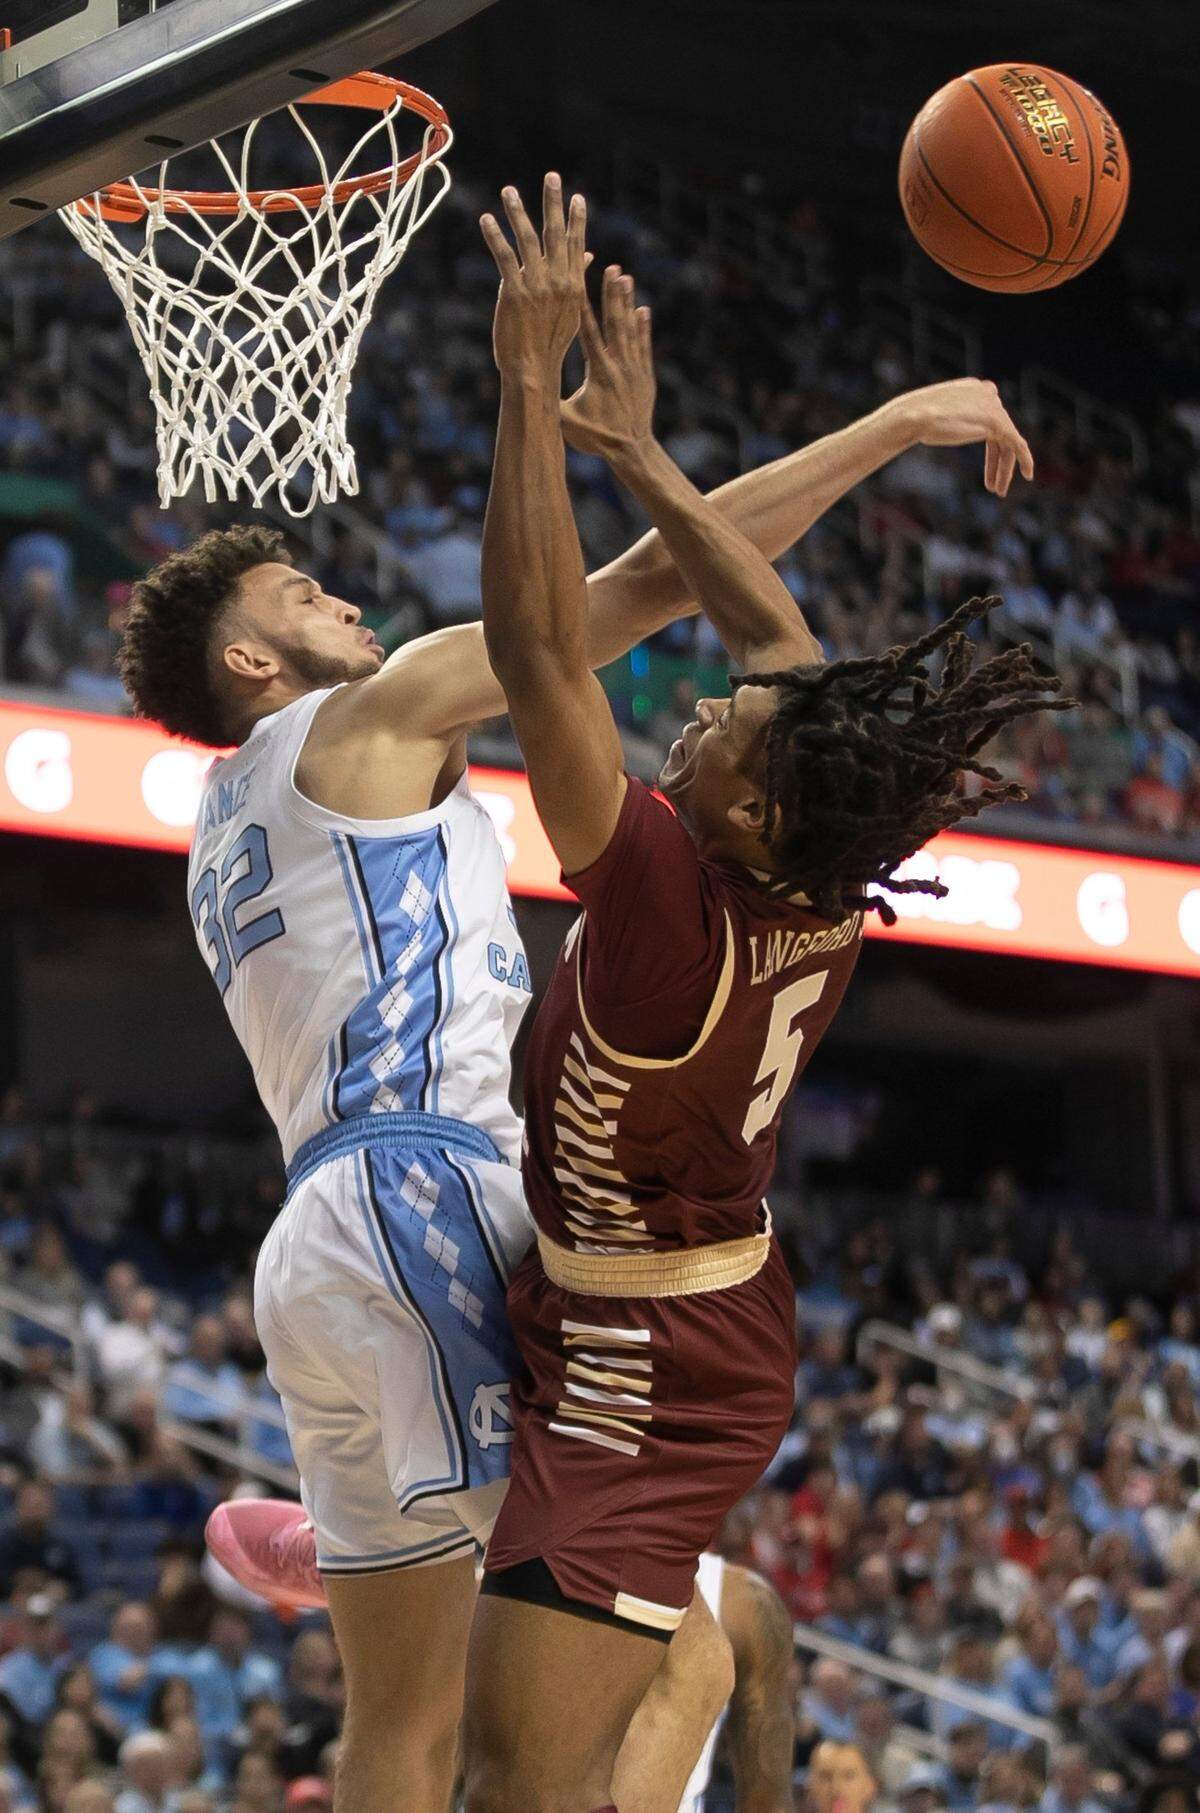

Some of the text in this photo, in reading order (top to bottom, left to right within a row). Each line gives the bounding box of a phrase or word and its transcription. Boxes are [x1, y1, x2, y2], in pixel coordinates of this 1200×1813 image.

[190, 822, 286, 1001] 32
[749, 910, 862, 987] LANGFORD
[741, 969, 830, 1147] 5
